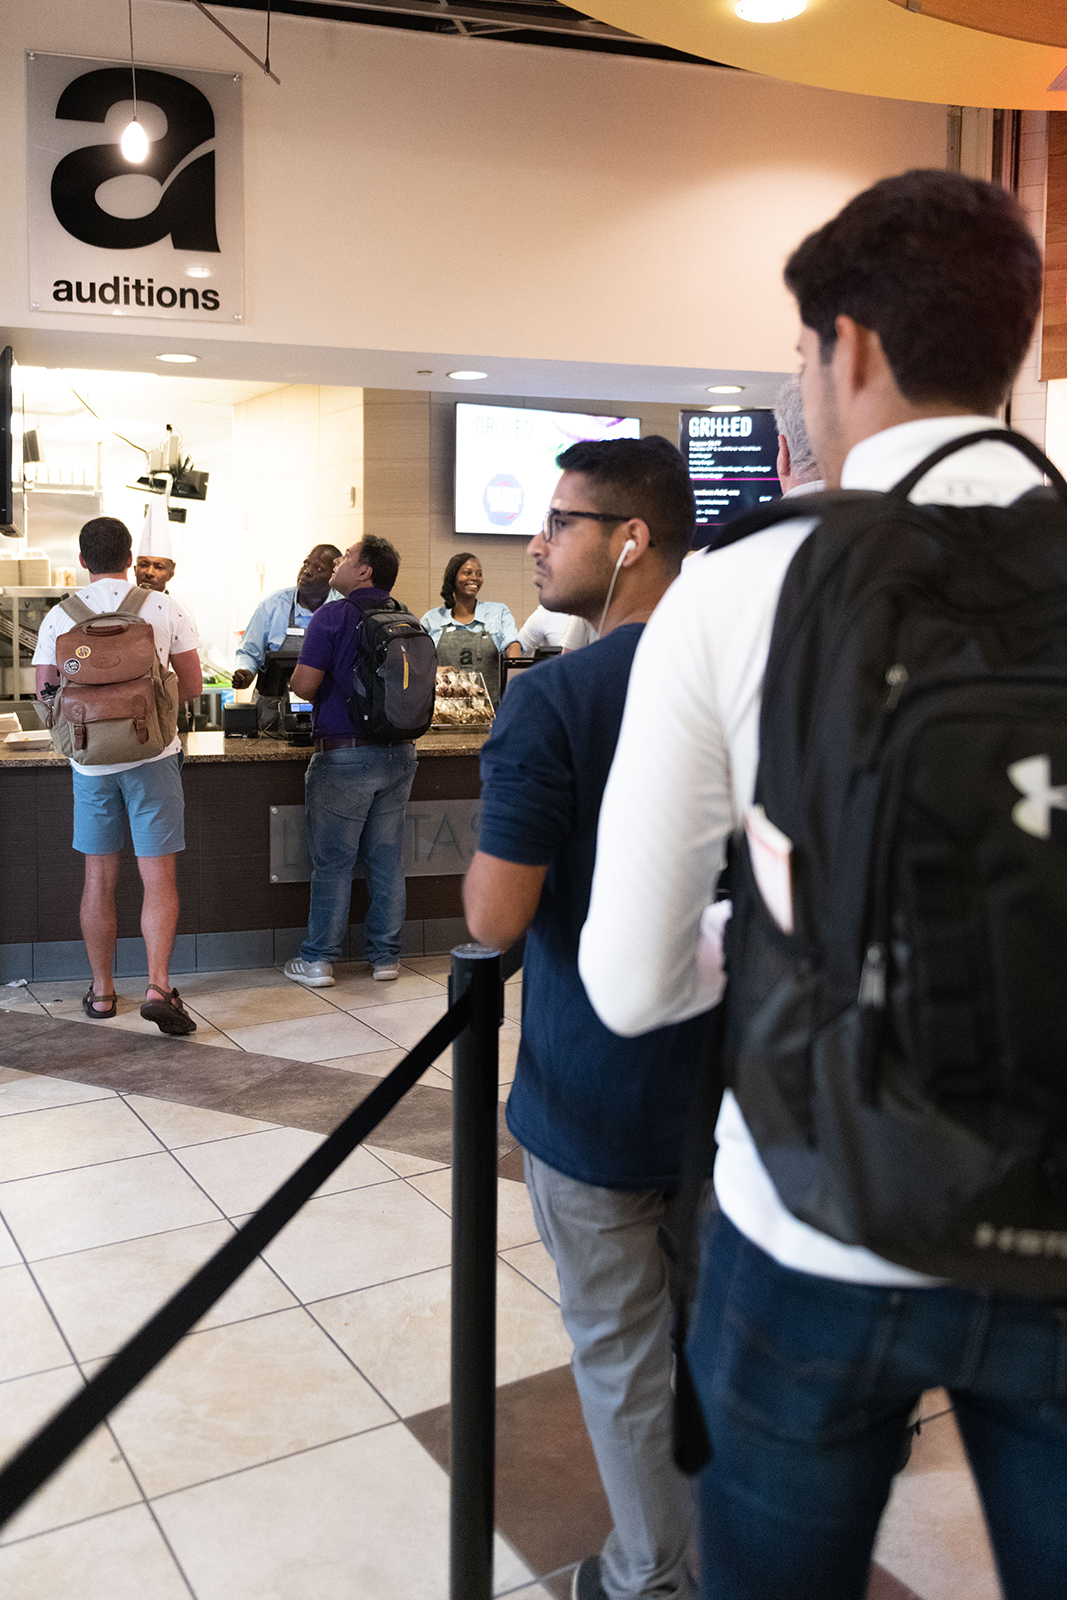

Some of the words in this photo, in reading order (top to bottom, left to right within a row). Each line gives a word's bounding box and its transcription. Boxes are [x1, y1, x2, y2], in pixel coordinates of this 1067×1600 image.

[51, 67, 221, 253] a
[52, 276, 220, 311] auditions
[689, 416, 753, 438] GRILLED
